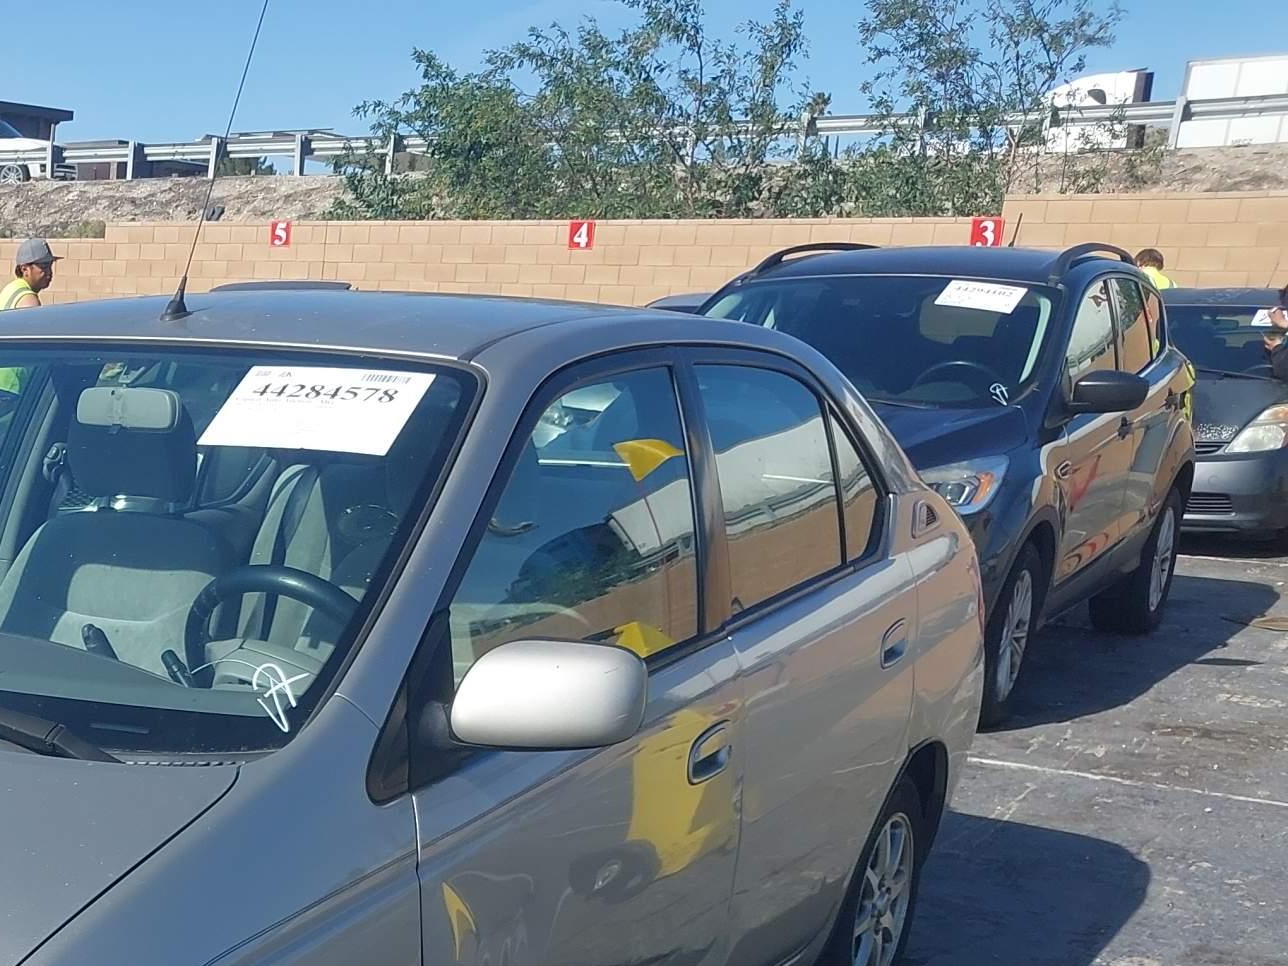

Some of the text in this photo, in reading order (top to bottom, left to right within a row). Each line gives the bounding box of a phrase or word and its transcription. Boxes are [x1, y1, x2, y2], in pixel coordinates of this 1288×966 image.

[273, 222, 287, 245] 5
[573, 222, 588, 247] 4
[976, 220, 995, 246] 3
[252, 383, 399, 403] 44284578
